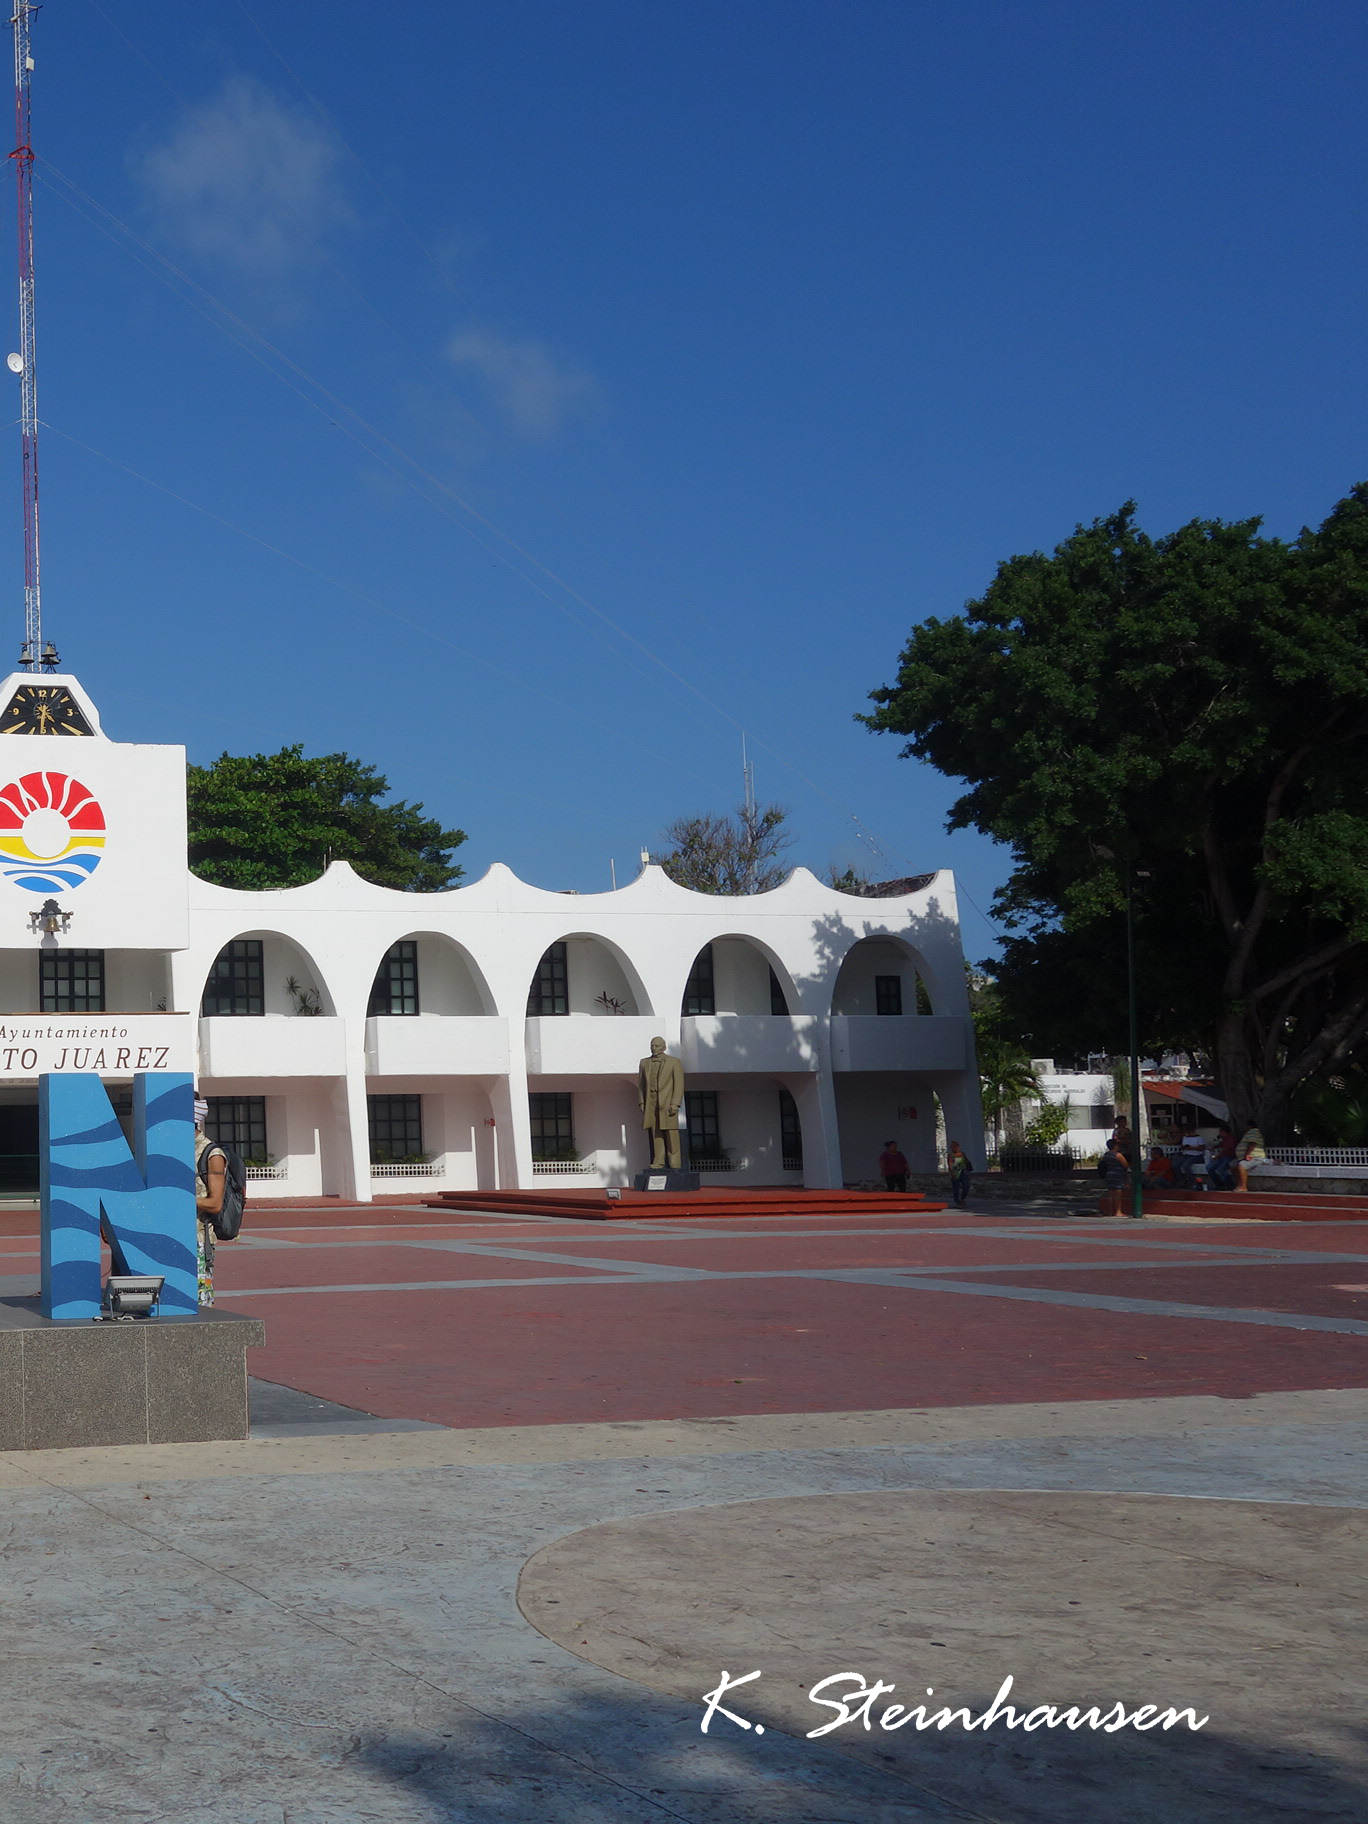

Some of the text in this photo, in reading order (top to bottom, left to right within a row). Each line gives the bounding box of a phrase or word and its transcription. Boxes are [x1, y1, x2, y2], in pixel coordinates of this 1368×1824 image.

[38, 689, 47, 698] 12
[12, 707, 20, 716] 9
[66, 708, 74, 717] 3
[54, 1047, 170, 1070] JUAREZ
